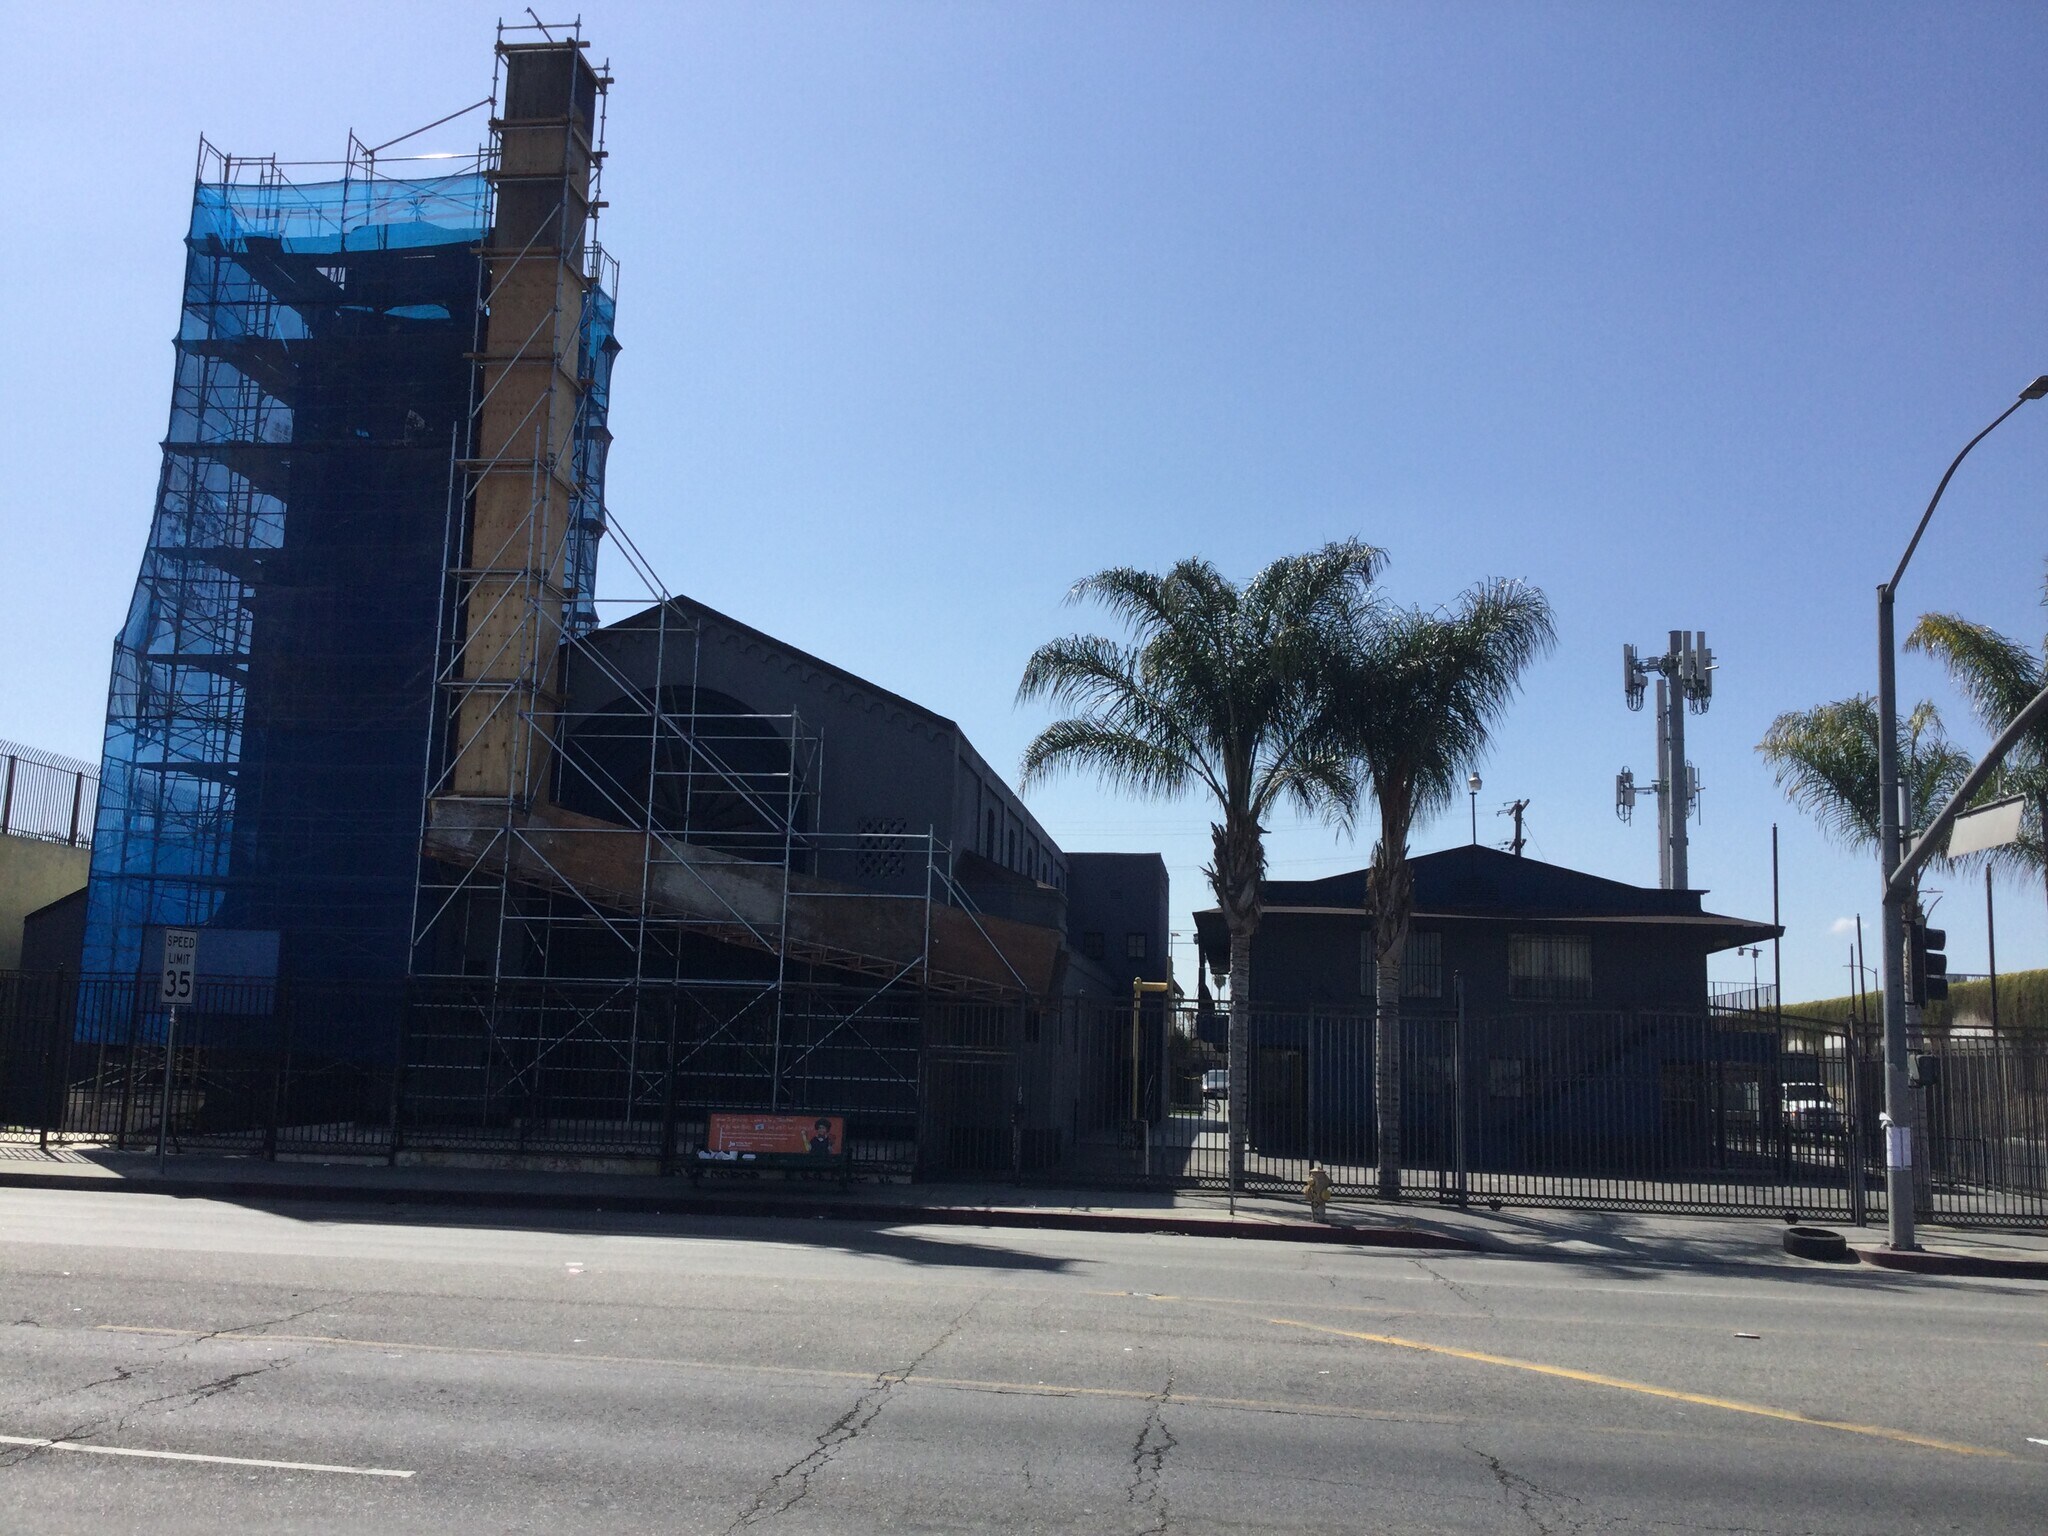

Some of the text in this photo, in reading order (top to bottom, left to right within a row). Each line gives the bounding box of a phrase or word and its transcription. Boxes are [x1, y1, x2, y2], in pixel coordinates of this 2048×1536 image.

[167, 935, 195, 949] SPEED
[168, 953, 191, 965] LIMIT
[164, 969, 191, 998] 35
